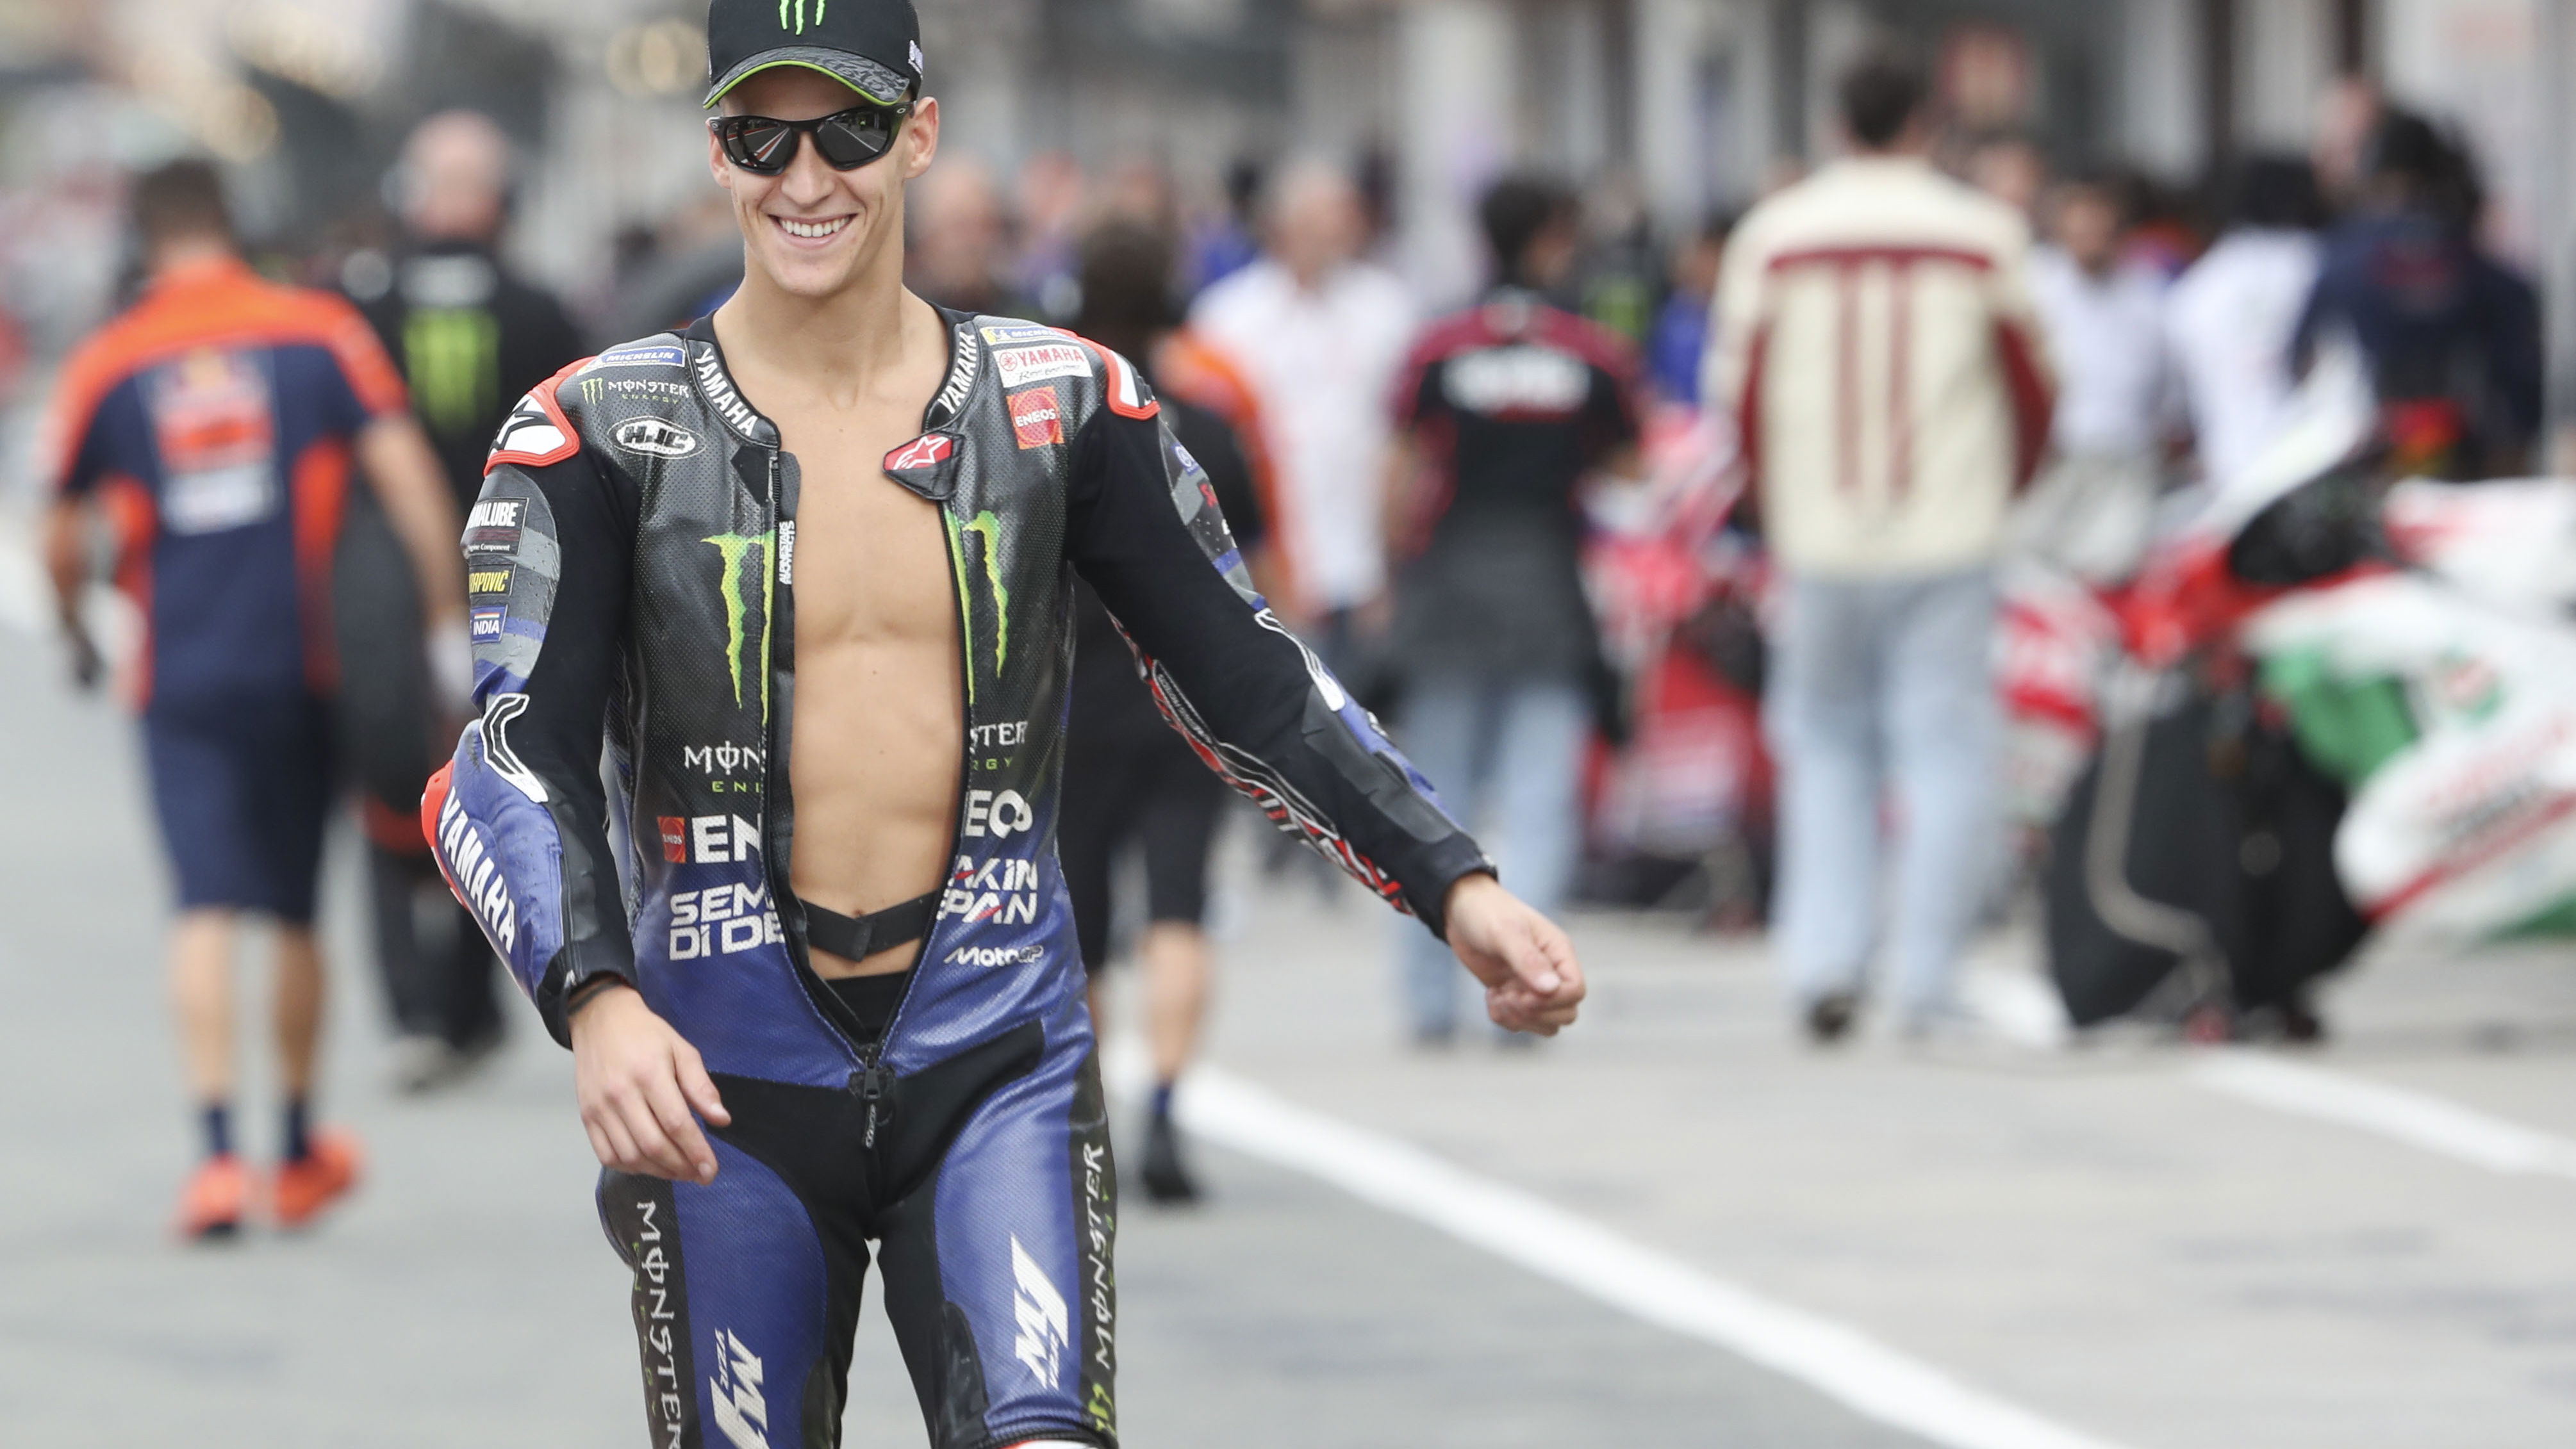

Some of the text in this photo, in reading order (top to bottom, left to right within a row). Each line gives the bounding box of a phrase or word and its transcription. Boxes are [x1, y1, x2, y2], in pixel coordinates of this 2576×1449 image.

[606, 352, 675, 362] MICHELIN
[1015, 348, 1085, 368] YAMAHA
[937, 331, 977, 415] YAMAHA
[607, 379, 689, 398] MONSTER
[694, 347, 760, 438] YAMAHA
[1014, 407, 1057, 428] ENEOS
[623, 425, 690, 449] HJC
[480, 543, 510, 552] Component
[473, 619, 500, 636] INDIA
[438, 785, 515, 955] YAMAHA
[669, 923, 711, 961] DI
[943, 944, 1044, 967] MotoGP
[1083, 1142, 1113, 1370] MONSTER
[636, 1199, 682, 1449] MONSTER
